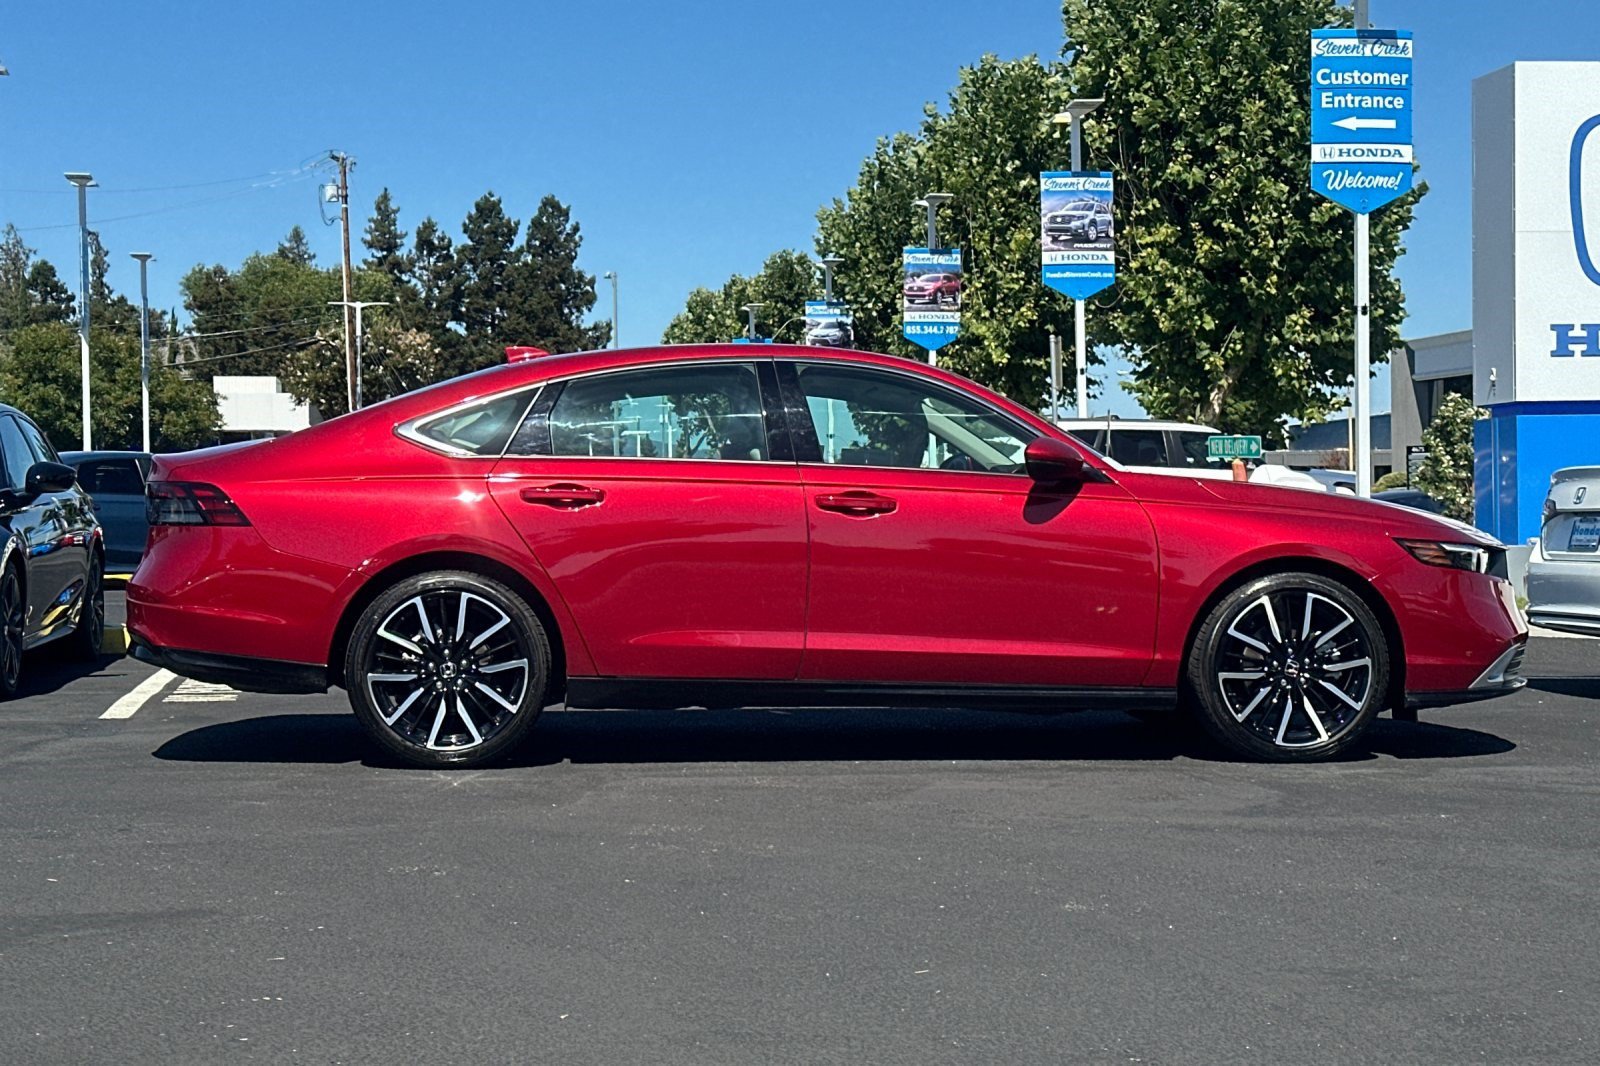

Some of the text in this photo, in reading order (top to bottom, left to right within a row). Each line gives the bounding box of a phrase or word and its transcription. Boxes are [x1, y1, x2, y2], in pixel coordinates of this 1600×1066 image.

[1315, 38, 1410, 57] Stevens Creek
[1316, 68, 1409, 85] Customer
[1321, 92, 1404, 108] Entrance
[1338, 148, 1404, 158] HONDA
[1044, 177, 1111, 190] Stevens Creek
[1322, 169, 1404, 190] Welcome!
[1060, 253, 1109, 261] HONDA
[1210, 439, 1248, 455] NEW DELIVERY
